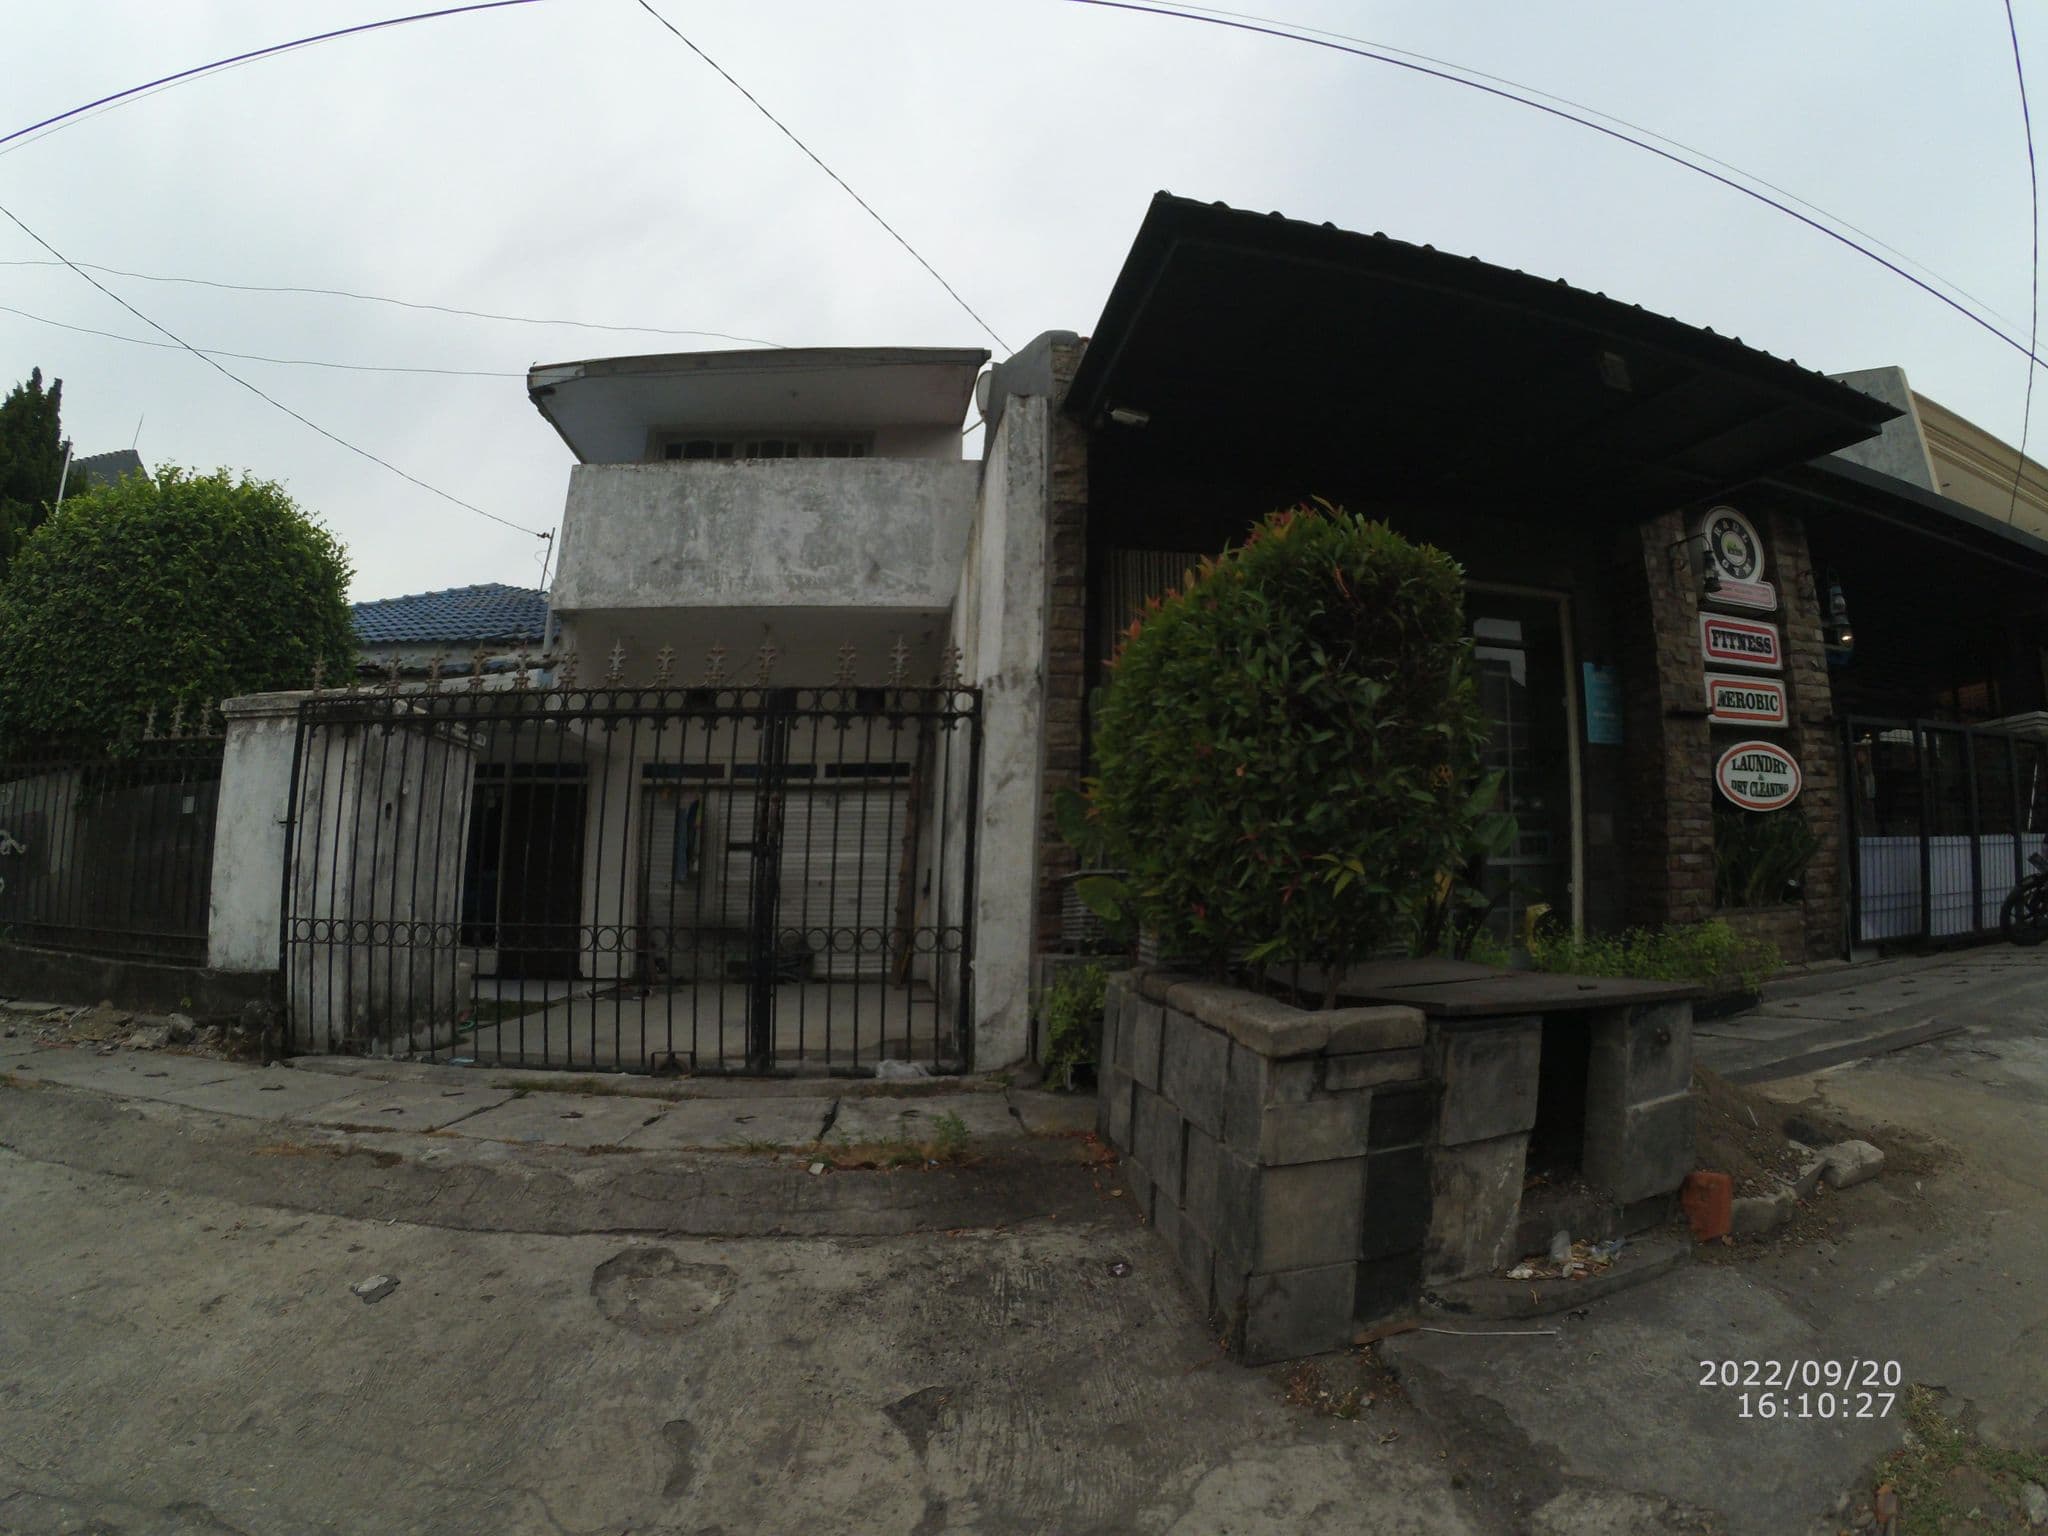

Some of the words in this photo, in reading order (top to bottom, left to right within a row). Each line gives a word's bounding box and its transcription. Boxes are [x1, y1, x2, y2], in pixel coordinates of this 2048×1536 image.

[1711, 629, 1772, 654] FITNESS
[1717, 690, 1778, 712] AEROBIC
[1731, 754, 1788, 775] LAUNDRY
[1731, 780, 1749, 796] DRY
[1750, 780, 1789, 798] CLEANING
